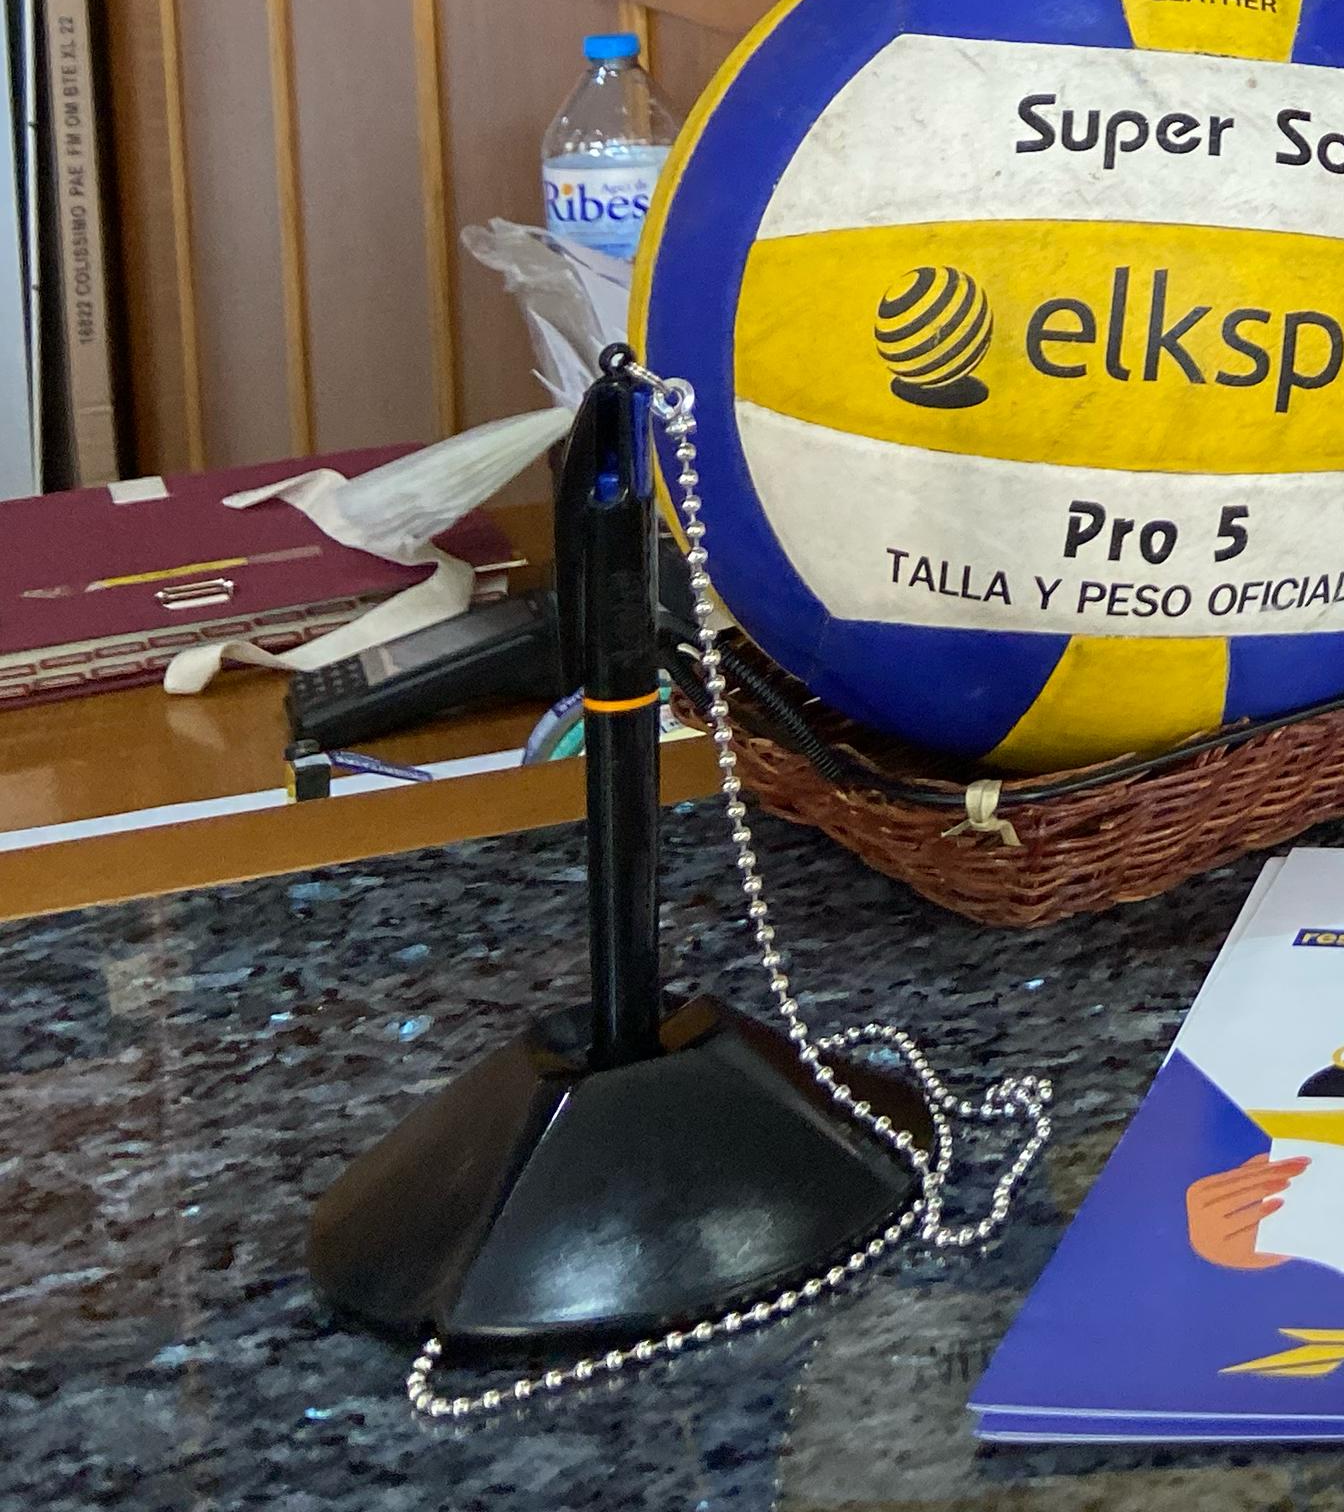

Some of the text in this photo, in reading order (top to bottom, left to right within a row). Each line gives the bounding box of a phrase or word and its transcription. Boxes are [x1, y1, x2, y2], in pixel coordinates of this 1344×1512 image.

[58, 16, 74, 34] 22
[60, 40, 76, 58] XL
[61, 65, 78, 96] BTE
[65, 133, 81, 155] FM
[1016, 94, 1234, 170] Super
[68, 165, 84, 196] PAE
[544, 179, 649, 222] Ribes
[70, 206, 91, 296] COLISSIMO
[1062, 500, 1250, 565] Pro 5
[886, 547, 1012, 606] TALLA
[1033, 577, 1063, 611] Y
[1076, 583, 1192, 619] PESO
